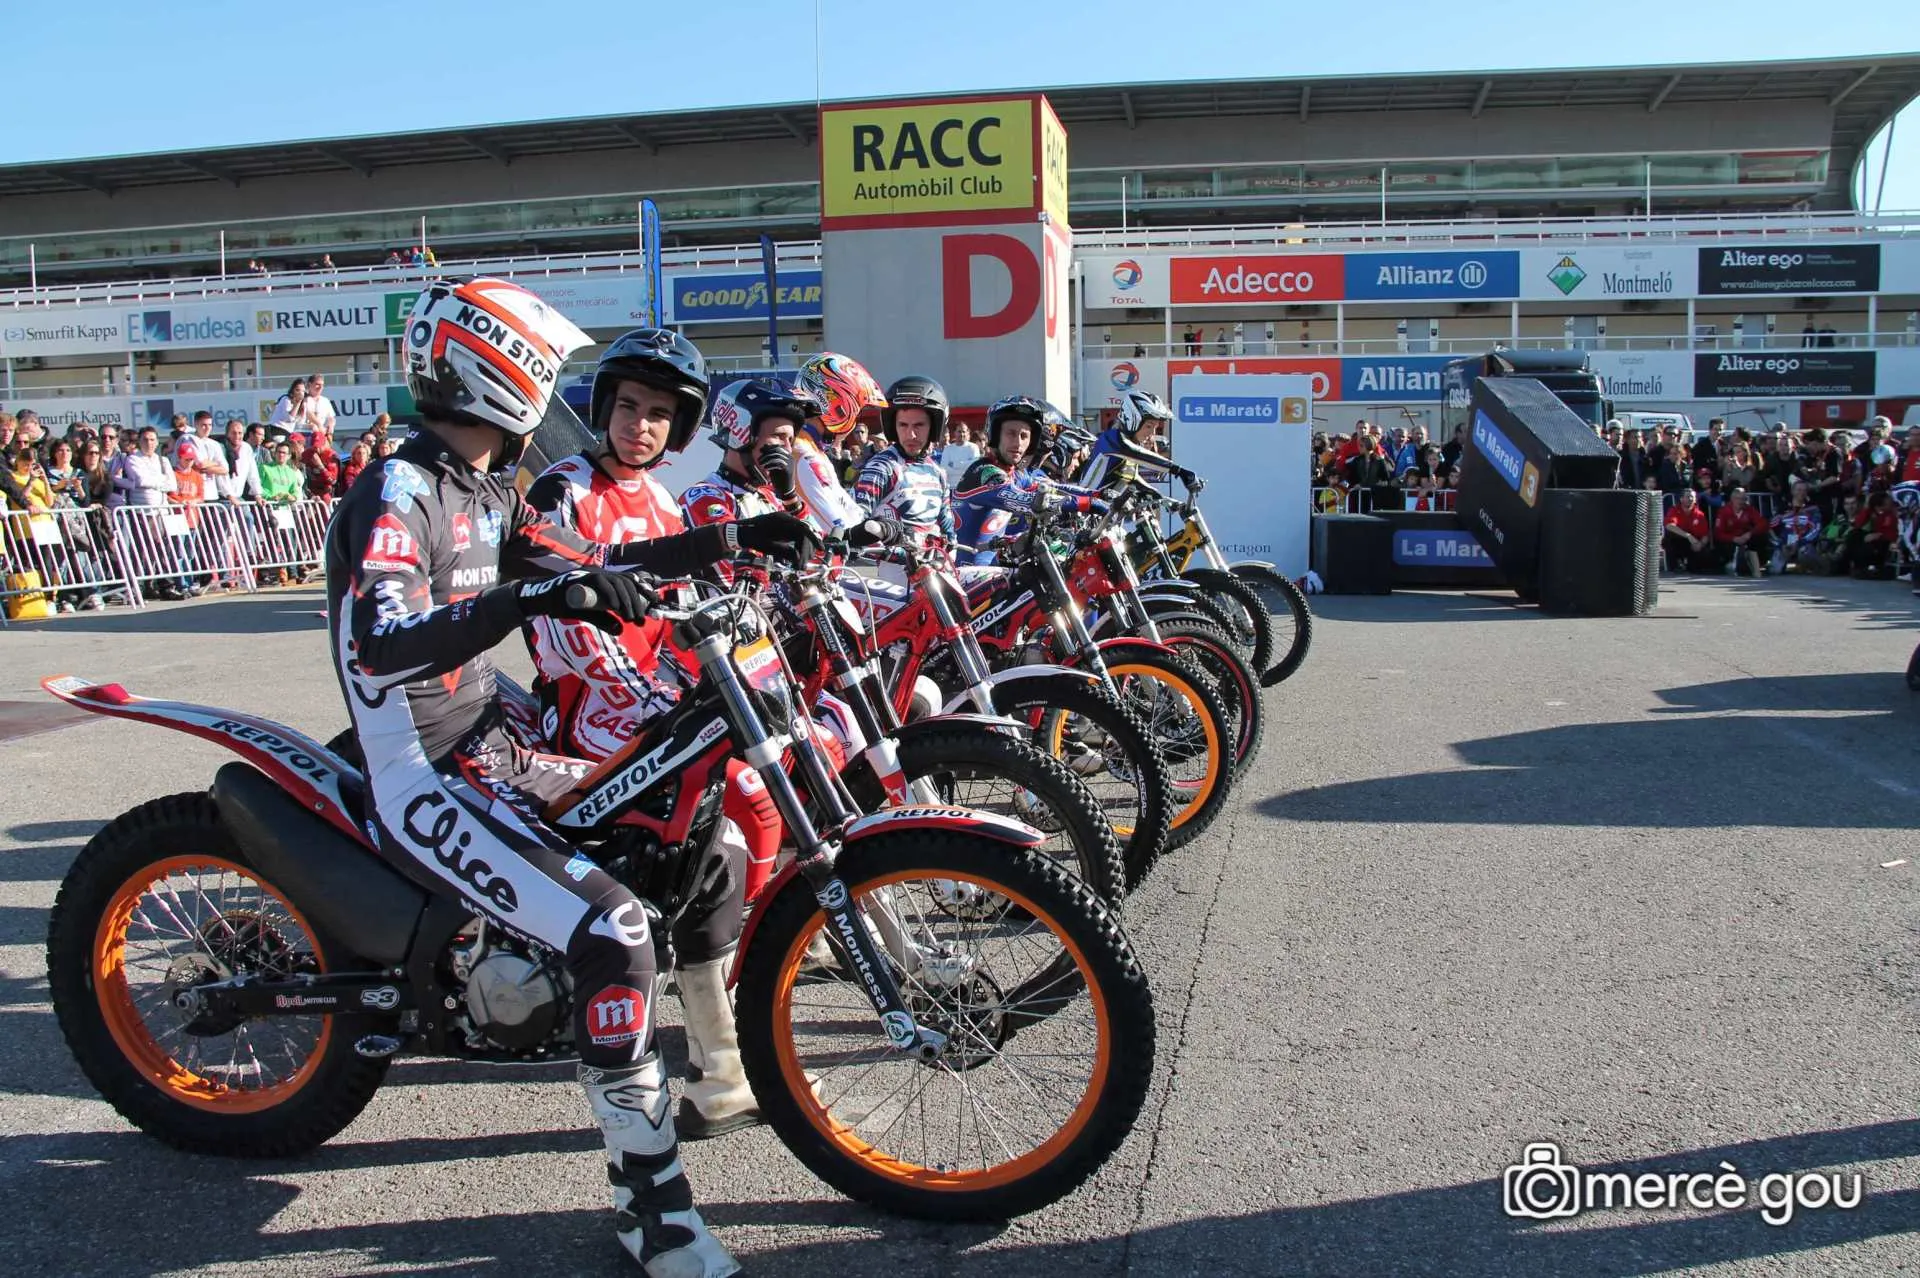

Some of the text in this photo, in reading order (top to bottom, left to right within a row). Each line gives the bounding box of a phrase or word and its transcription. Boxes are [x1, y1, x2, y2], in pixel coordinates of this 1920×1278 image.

[852, 116, 1003, 173] RACC
[853, 174, 1003, 201] Automòbil Club
[1719, 250, 1766, 267] Alter
[1767, 253, 1803, 270] ego
[941, 232, 1041, 340] D
[1199, 264, 1314, 295] Adecco
[1376, 265, 1454, 286] Allianz
[1602, 271, 1672, 295] Montmeló
[1109, 296, 1146, 305] TOTAL
[173, 315, 245, 341] endesa
[276, 306, 379, 330] RENAULT
[26, 323, 118, 343] Smurfit Kappa
[455, 304, 554, 385] NON STOP
[1716, 354, 1764, 371] Alter
[1765, 357, 1800, 375] ego
[1600, 374, 1663, 396] Montmeló
[38, 409, 121, 426] murfit Kappa
[1184, 401, 1273, 418] La Marató
[1291, 403, 1304, 418] 3
[1475, 419, 1520, 479] La Marató
[1526, 474, 1536, 498] 3
[1401, 538, 1428, 556] La
[971, 608, 1000, 632] PSOL
[210, 719, 335, 784] REPSOL
[577, 755, 664, 826] REPSOL
[892, 807, 975, 820] REPSOL
[402, 790, 518, 913] Clice
[834, 913, 888, 1010] Montesa
[360, 985, 400, 1010] S3
[595, 1032, 641, 1043] Montesa
